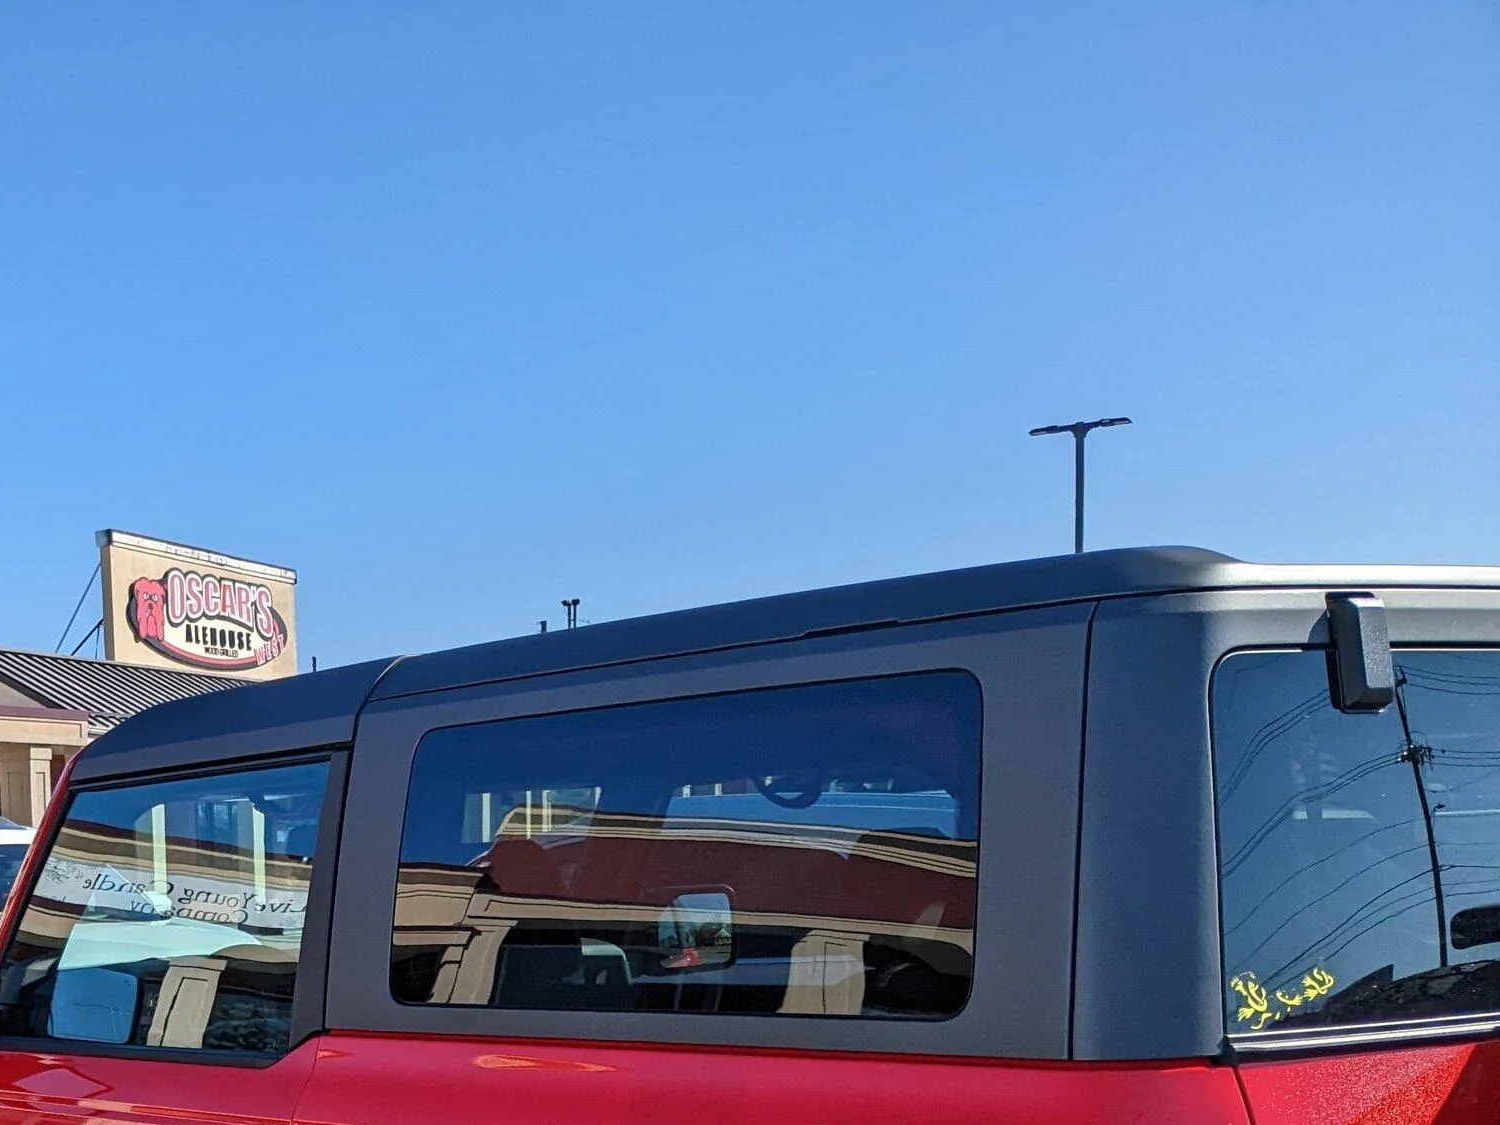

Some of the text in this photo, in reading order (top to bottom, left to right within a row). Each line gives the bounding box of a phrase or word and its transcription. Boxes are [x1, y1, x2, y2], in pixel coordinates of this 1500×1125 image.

[166, 570, 275, 638] OSCAR'S
[185, 624, 252, 651] ALEHOUSE
[204, 646, 239, 658] WOOD GRILLED
[254, 634, 285, 665] WEST
